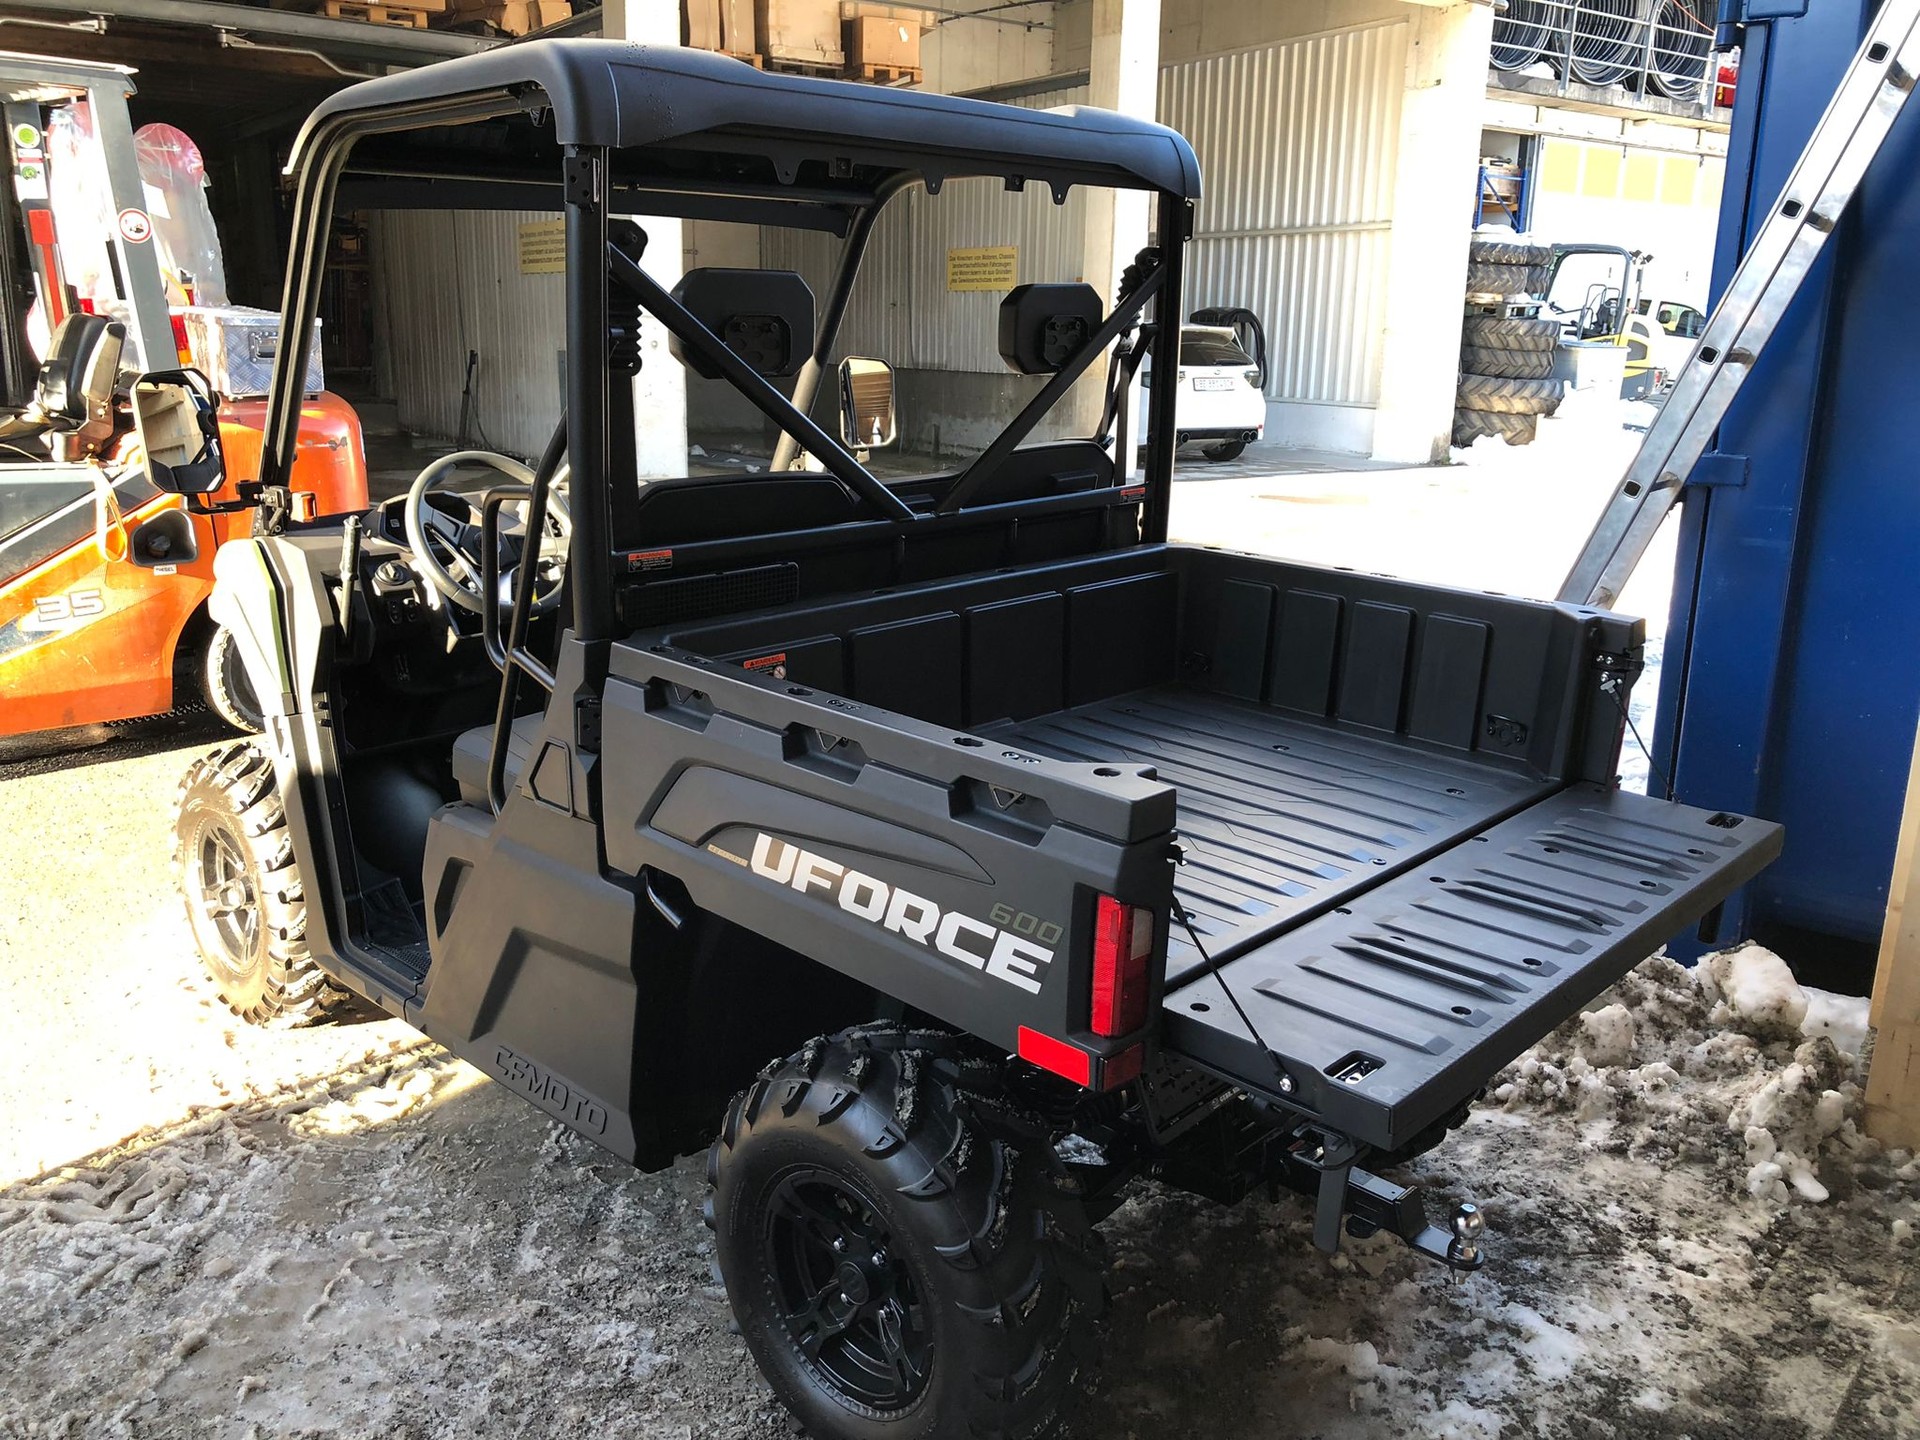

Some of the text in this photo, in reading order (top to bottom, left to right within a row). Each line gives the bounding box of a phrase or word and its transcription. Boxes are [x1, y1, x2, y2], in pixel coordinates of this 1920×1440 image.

[31, 587, 106, 623] 35
[748, 832, 1055, 995] UFORCE
[989, 902, 1065, 945] 600
